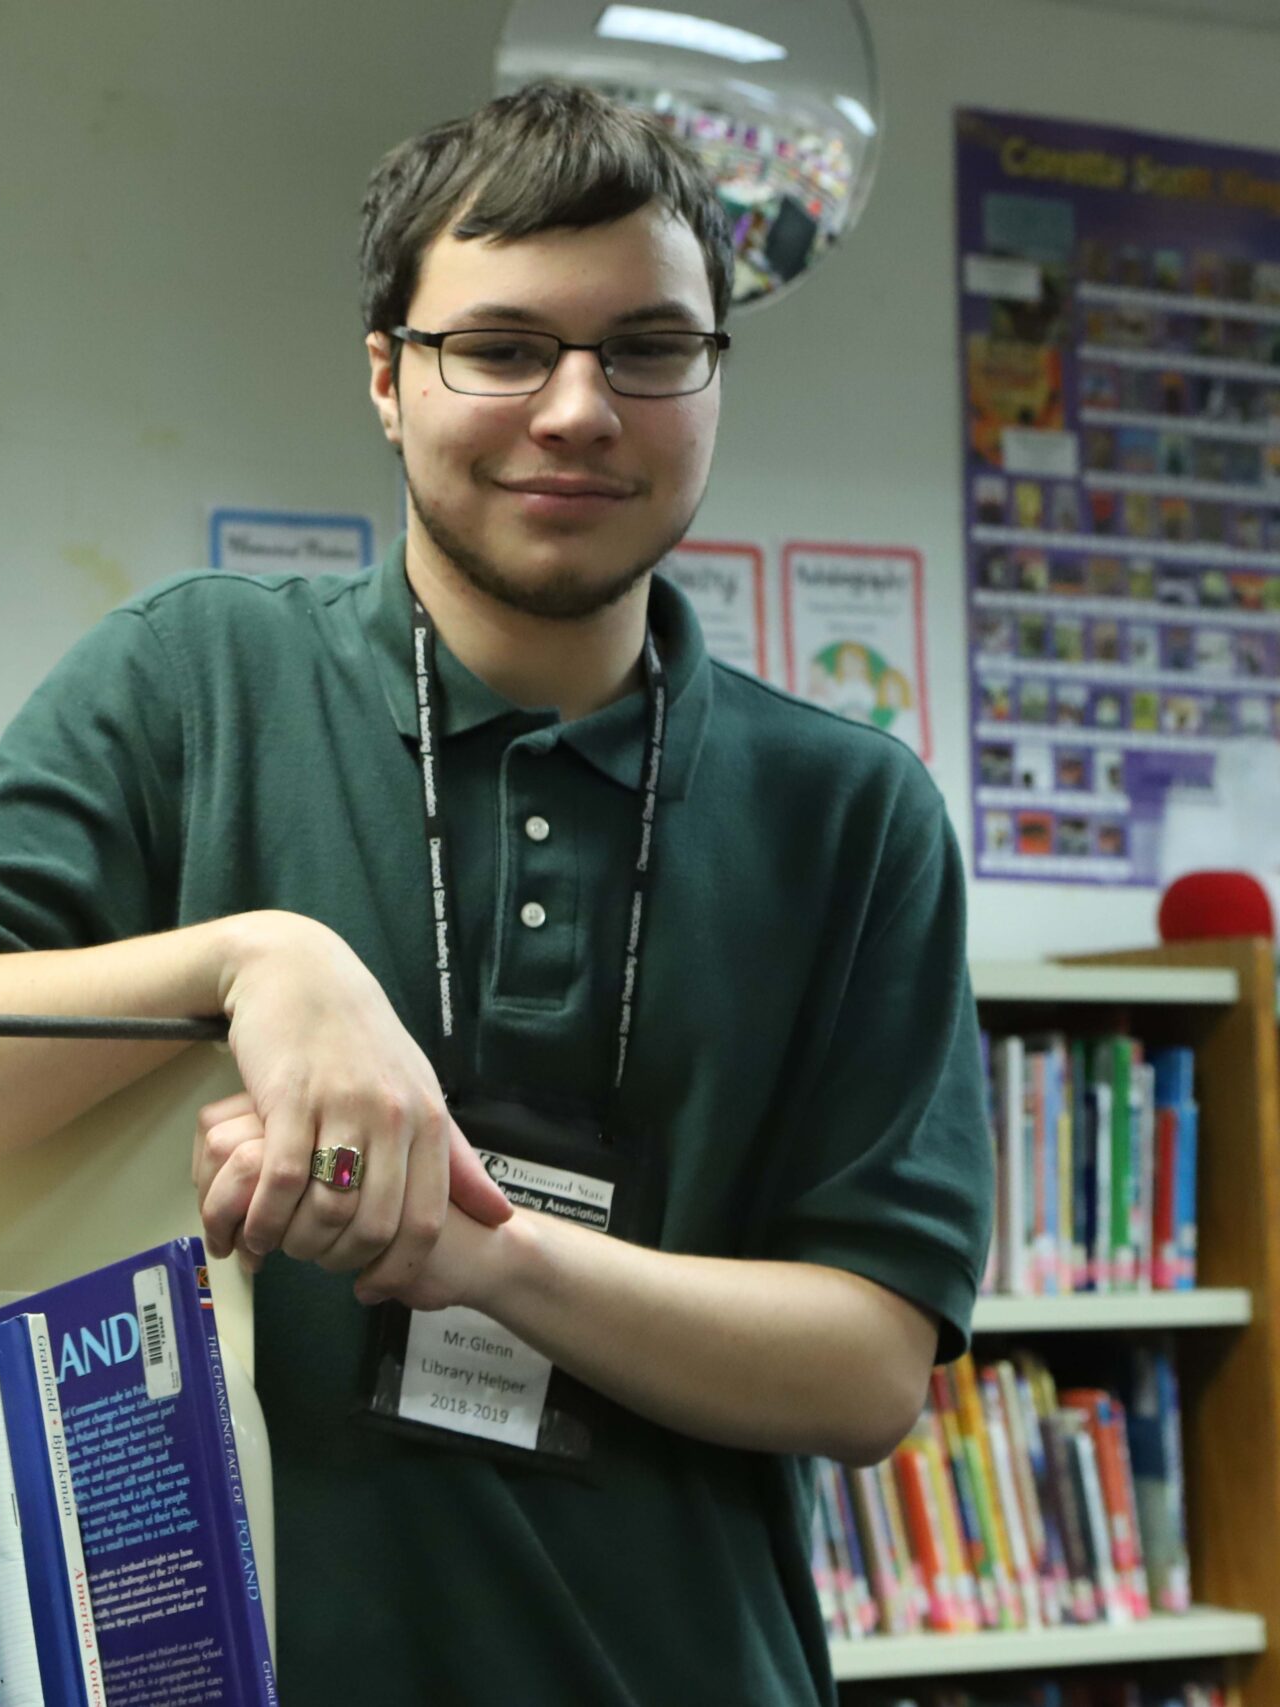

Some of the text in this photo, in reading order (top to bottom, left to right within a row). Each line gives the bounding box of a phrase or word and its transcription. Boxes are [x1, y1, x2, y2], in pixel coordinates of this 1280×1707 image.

[420, 706, 432, 753] Reading
[422, 754, 437, 818] Association
[429, 837, 445, 888] Diamond
[436, 920, 450, 970] Reading
[439, 970, 455, 1037] Association
[512, 1167, 606, 1202] Diamond State
[545, 1198, 606, 1224] Association
[56, 1311, 141, 1386] AND
[443, 1329, 514, 1359] Mr.Glenn
[422, 1357, 527, 1395] Library Helper
[37, 1334, 73, 1517] Granfield Björkman
[207, 1334, 243, 1505] THE CHANGING FACE OF
[429, 1392, 510, 1425] 2018-2019
[236, 1519, 259, 1601] POLAND
[74, 1566, 93, 1650] America
